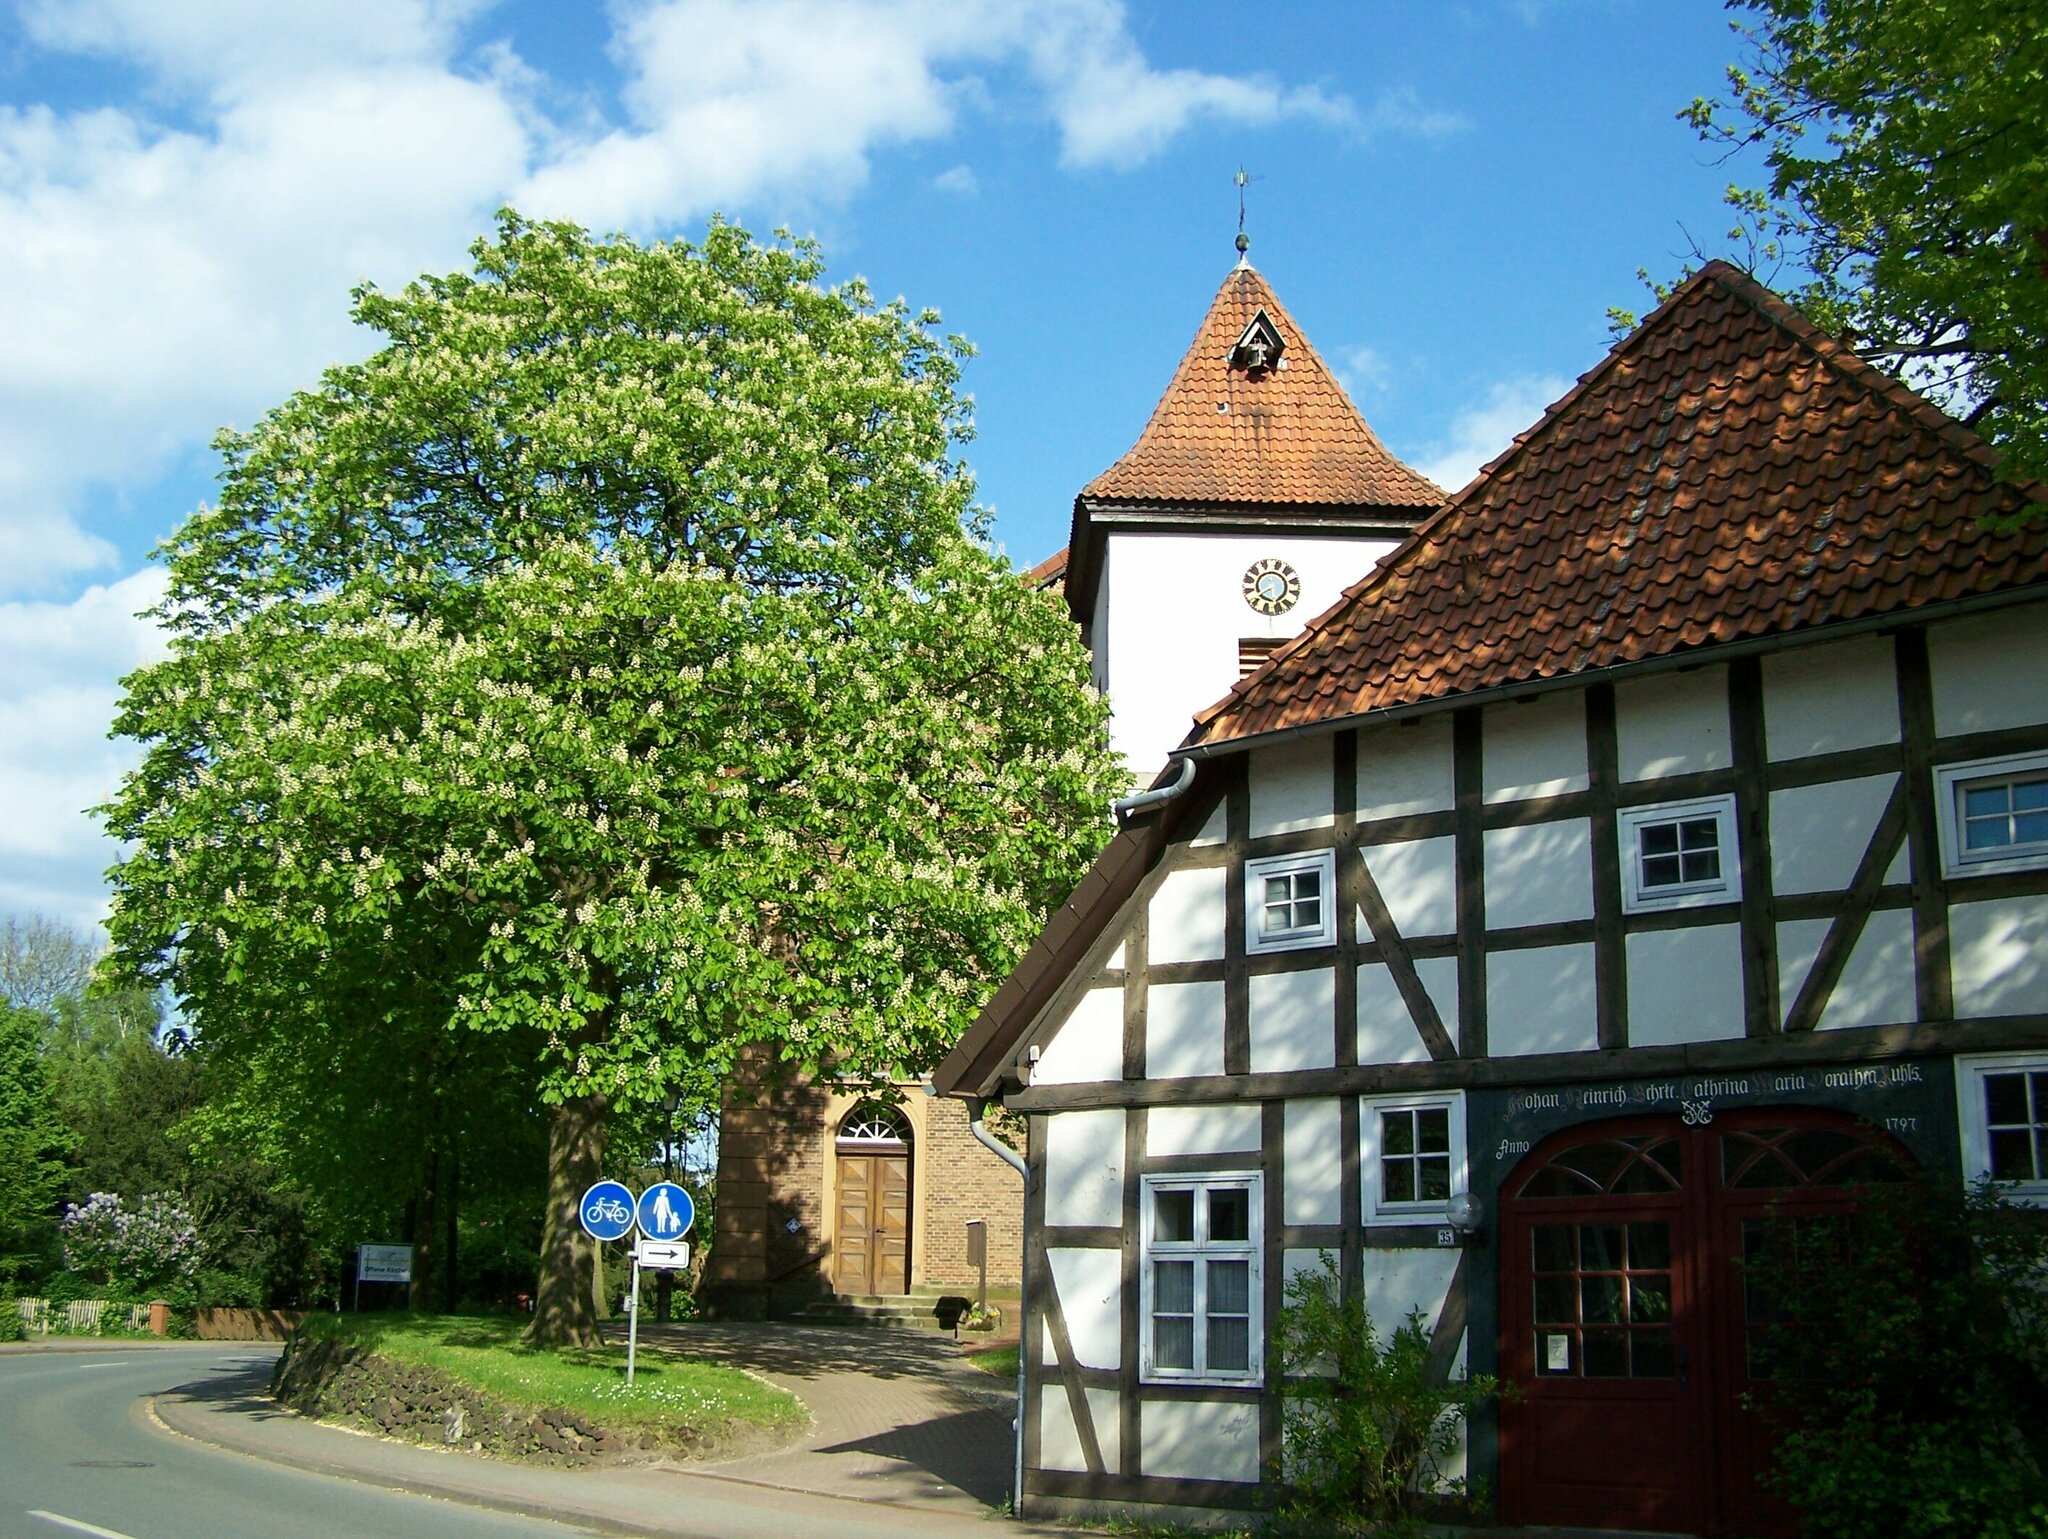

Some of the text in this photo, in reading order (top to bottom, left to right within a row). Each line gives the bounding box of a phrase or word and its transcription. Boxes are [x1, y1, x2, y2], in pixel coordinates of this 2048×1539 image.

[1750, 1071, 1806, 1096] Maria
[1884, 1117, 1917, 1133] 1797
[1495, 1138, 1531, 1161] Anno
[1440, 1231, 1451, 1243] 35
